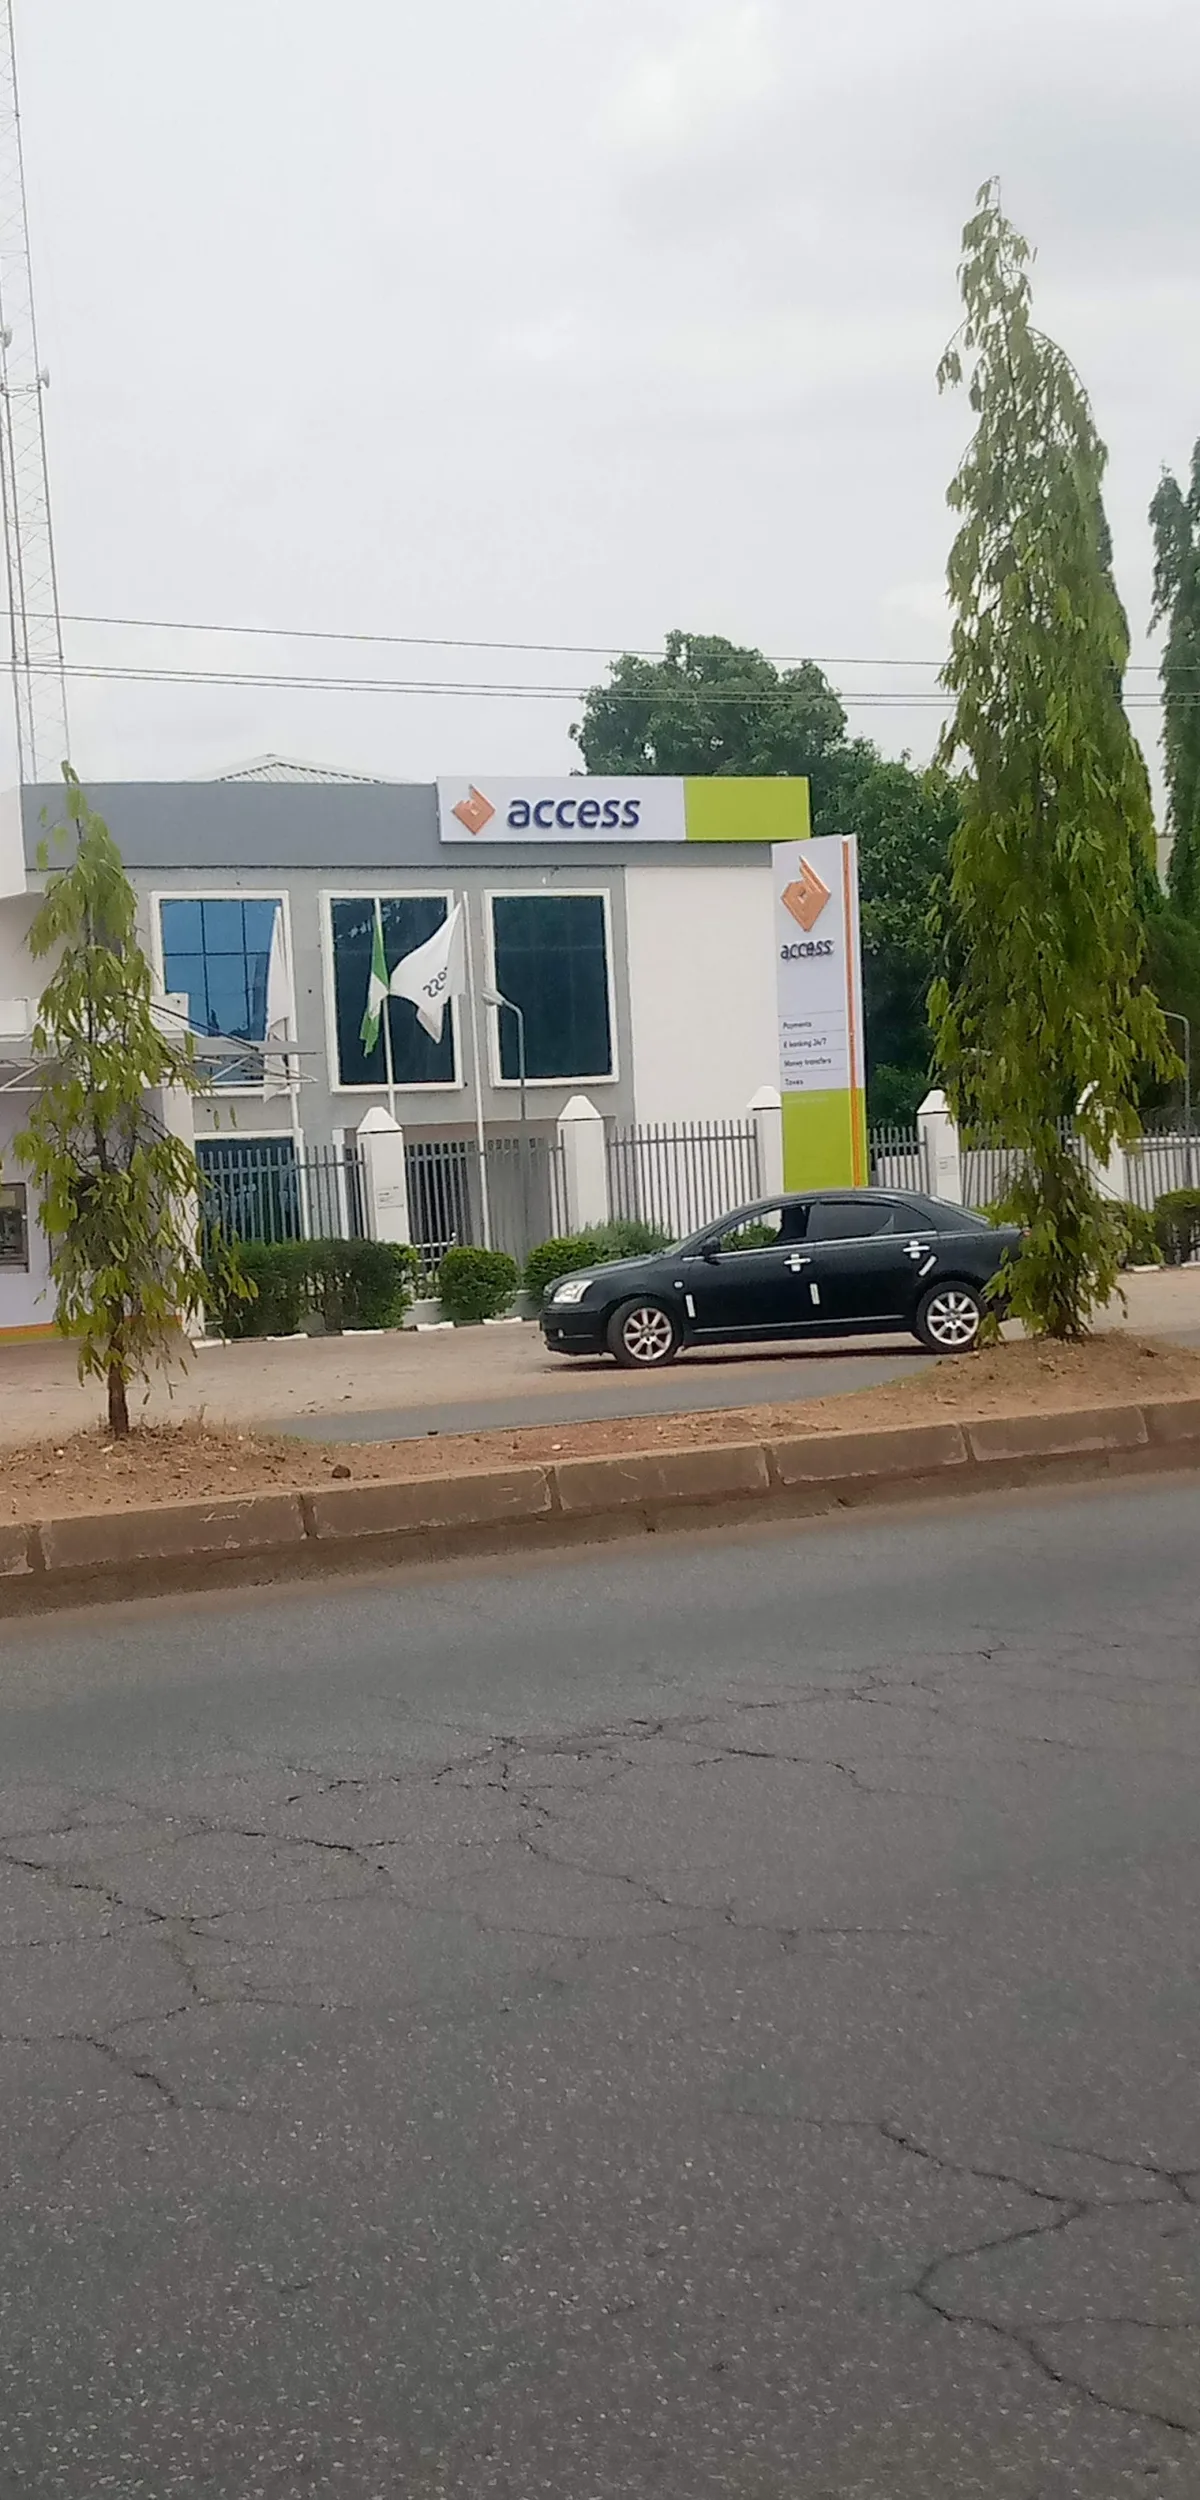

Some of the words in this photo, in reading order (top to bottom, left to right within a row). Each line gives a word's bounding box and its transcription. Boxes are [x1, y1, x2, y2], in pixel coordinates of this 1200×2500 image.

[508, 799, 641, 829] access
[780, 939, 834, 960] access
[783, 1021, 812, 1030] Payments
[784, 1060, 803, 1068] Money
[804, 1057, 832, 1065] transfers
[785, 1078, 804, 1086] Taxes
